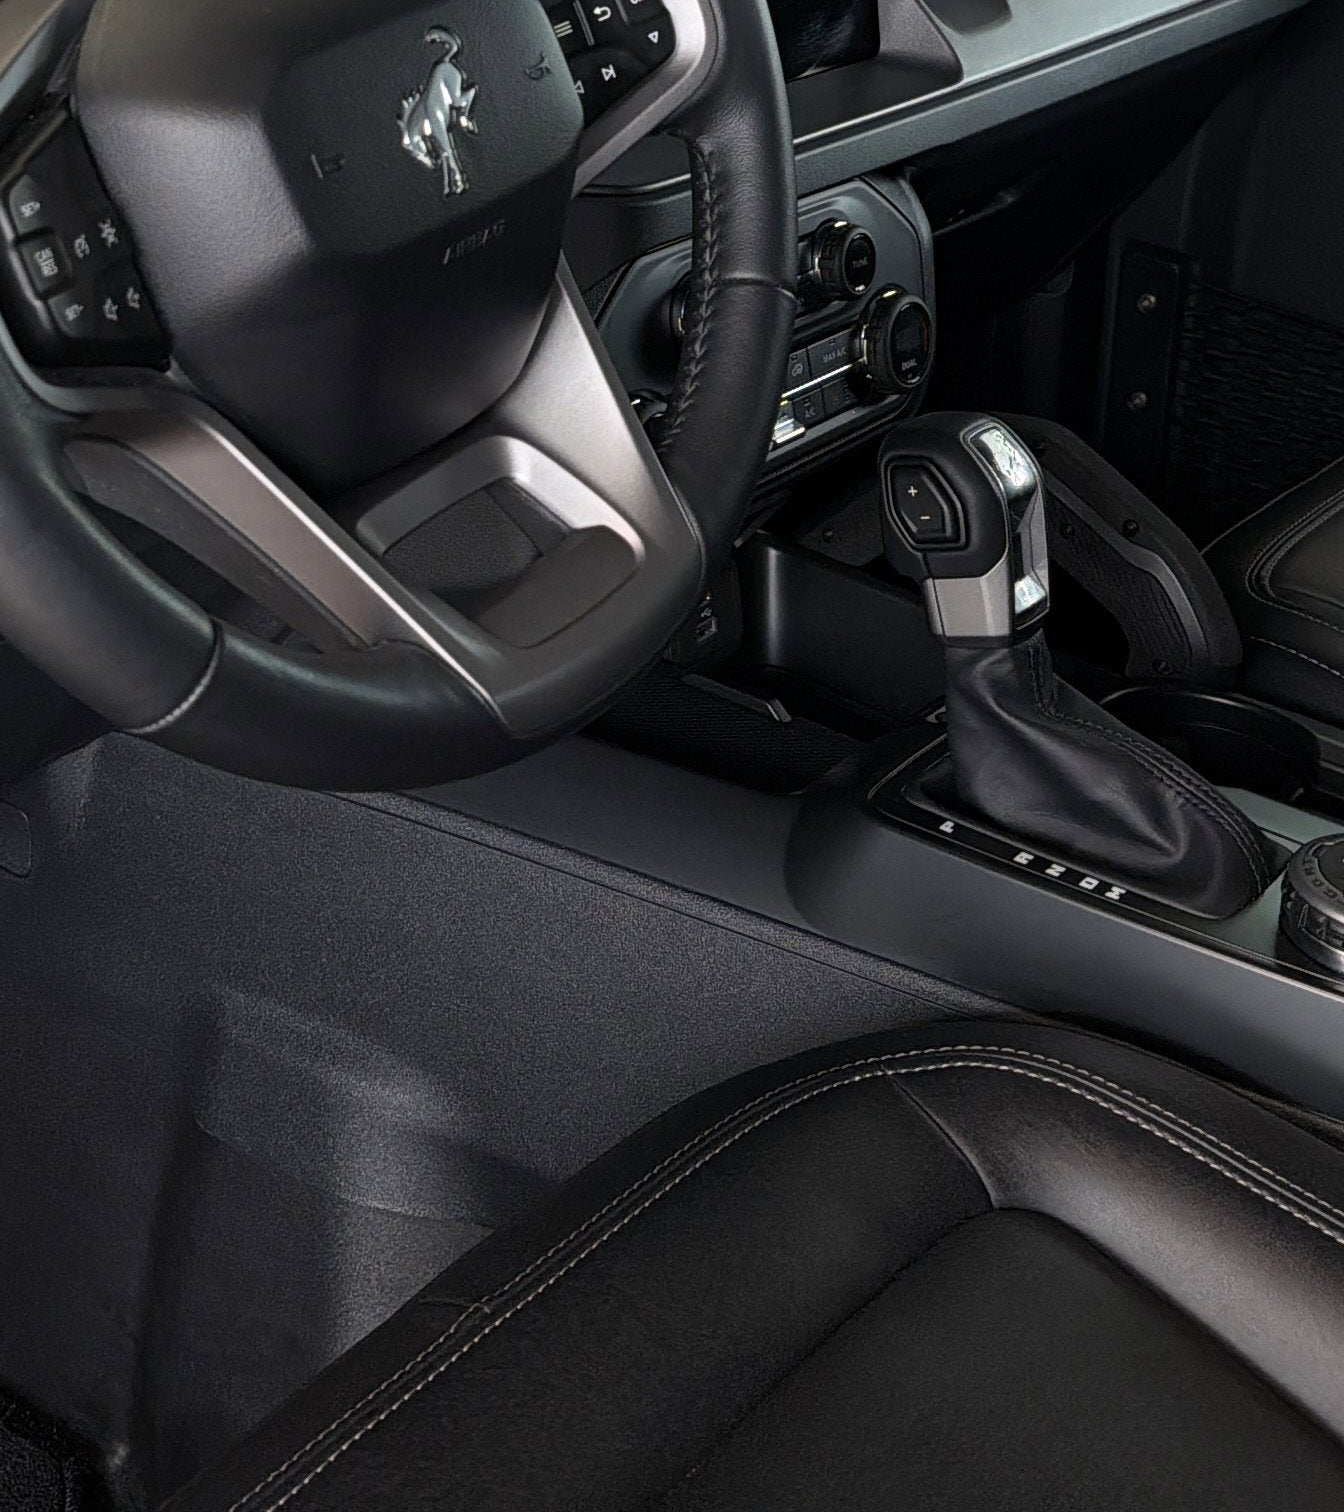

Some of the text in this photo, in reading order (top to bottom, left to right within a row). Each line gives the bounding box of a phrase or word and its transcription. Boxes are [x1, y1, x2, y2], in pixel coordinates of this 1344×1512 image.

[939, 820, 1127, 900] P R N D M
